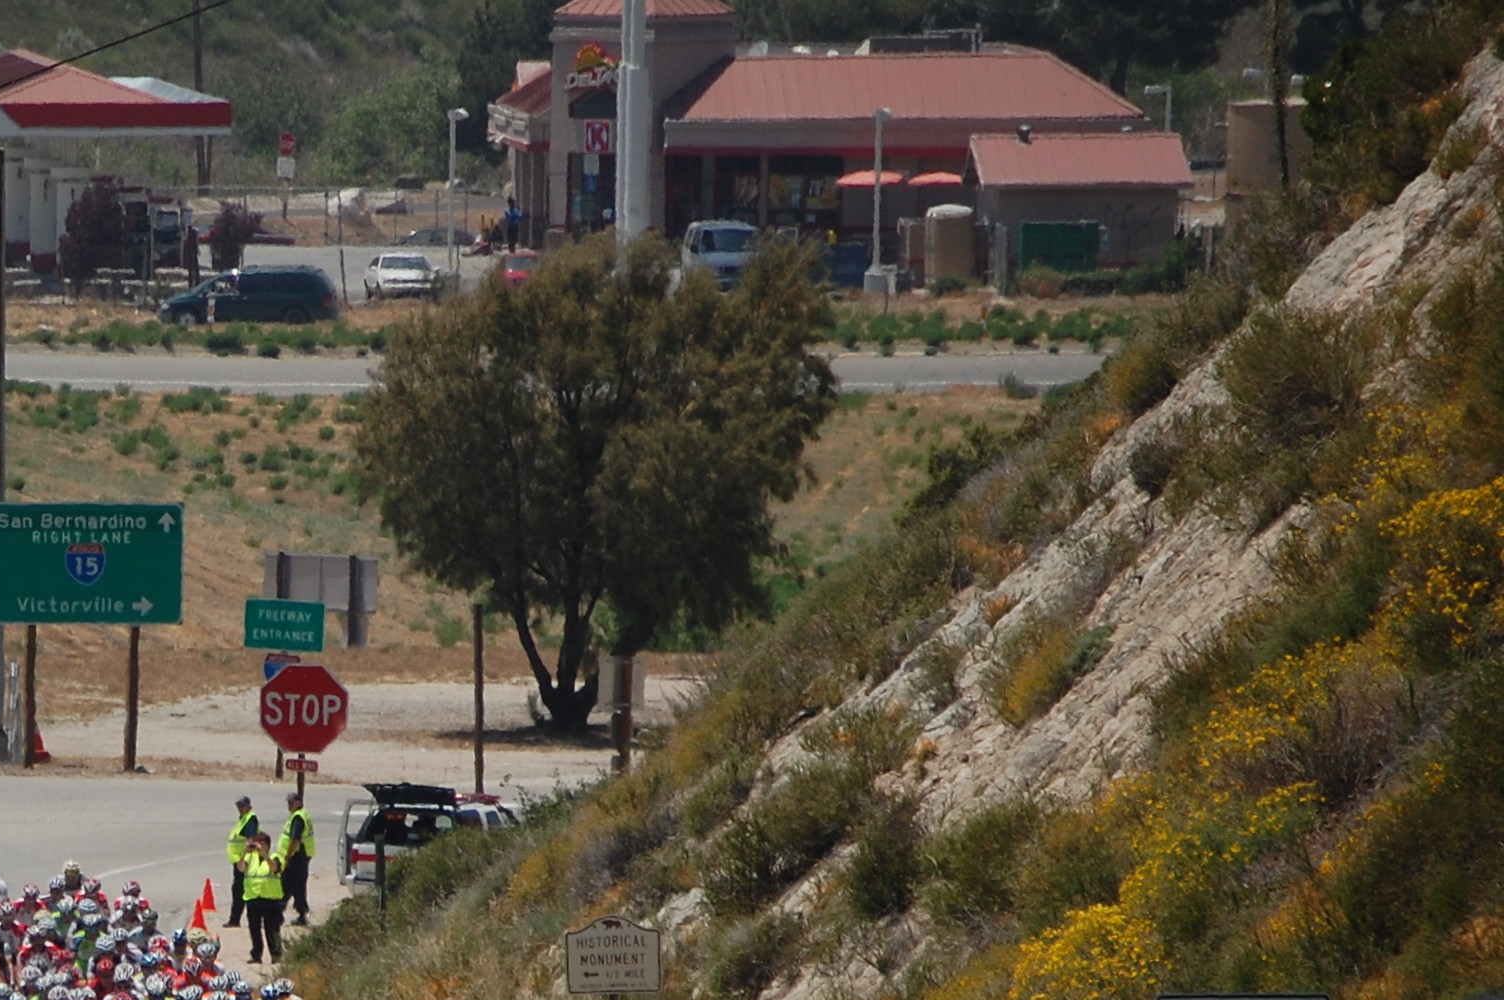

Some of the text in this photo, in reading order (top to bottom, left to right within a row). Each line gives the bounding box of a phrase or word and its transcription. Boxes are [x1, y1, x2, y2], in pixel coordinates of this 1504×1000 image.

[41, 513, 147, 530] Bernardino
[32, 531, 132, 544] RIGHT LANE
[74, 556, 99, 576] 15
[17, 597, 125, 614] Victorville
[258, 609, 313, 623] FREEWAY
[252, 628, 315, 642] ENTRANCE
[265, 691, 342, 727] STOP
[576, 935, 648, 949] HISTORICAL
[580, 953, 646, 966] MONUMENT
[624, 968, 645, 978] MILE
